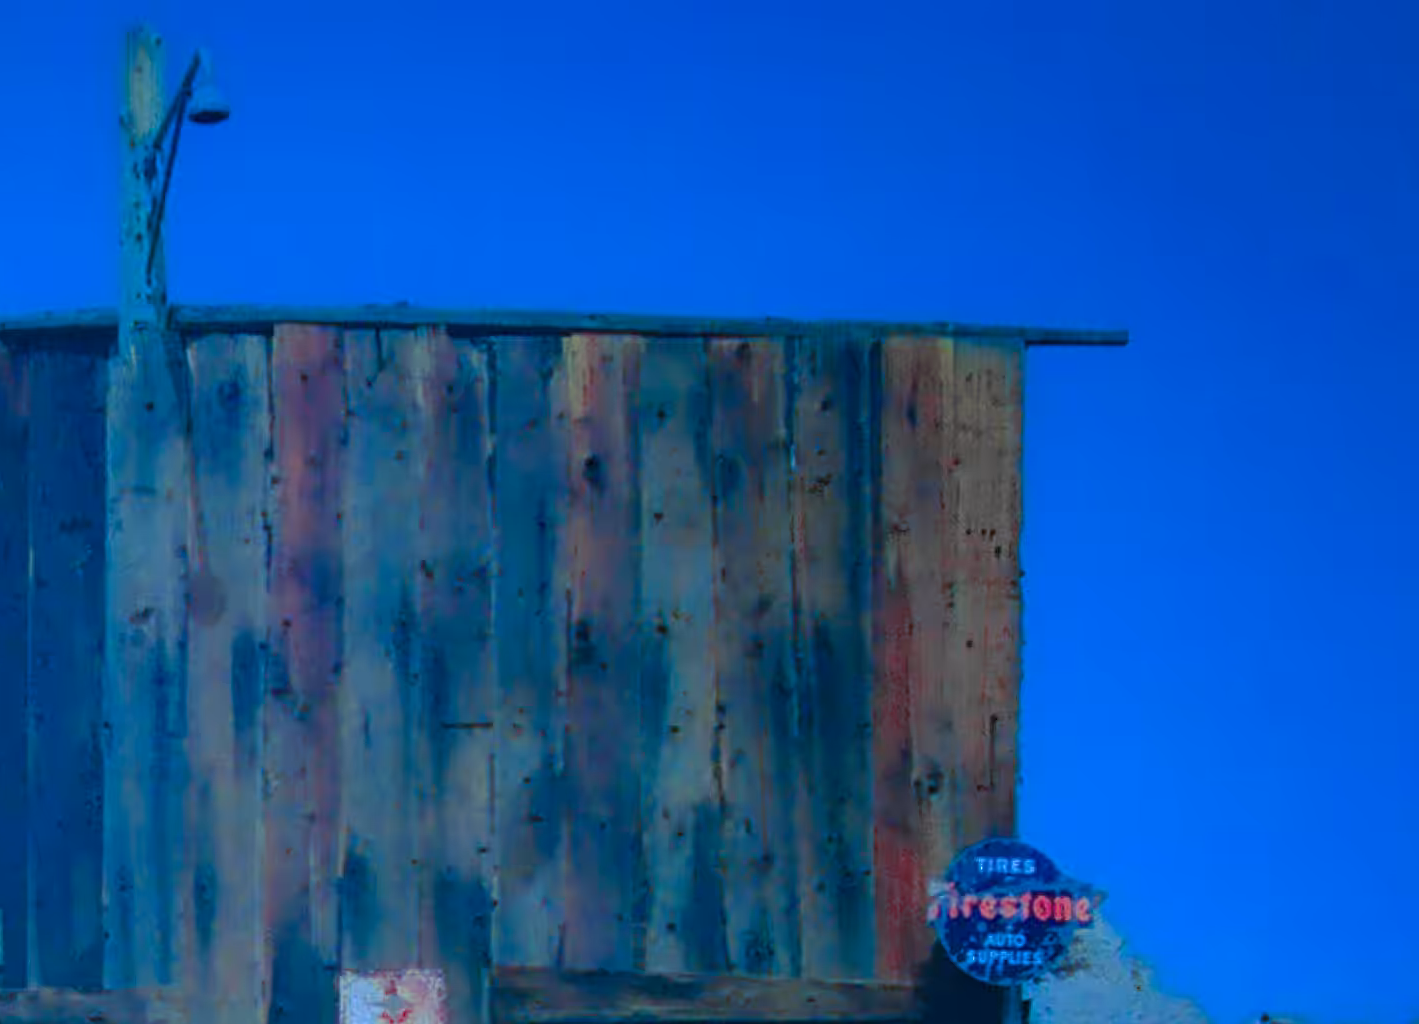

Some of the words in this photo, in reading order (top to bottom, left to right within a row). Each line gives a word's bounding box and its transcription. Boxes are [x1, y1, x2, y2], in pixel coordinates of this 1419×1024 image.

[978, 857, 1037, 875] TIRES
[985, 931, 1027, 947] AUTO
[966, 950, 1043, 966] SUPPLIES
